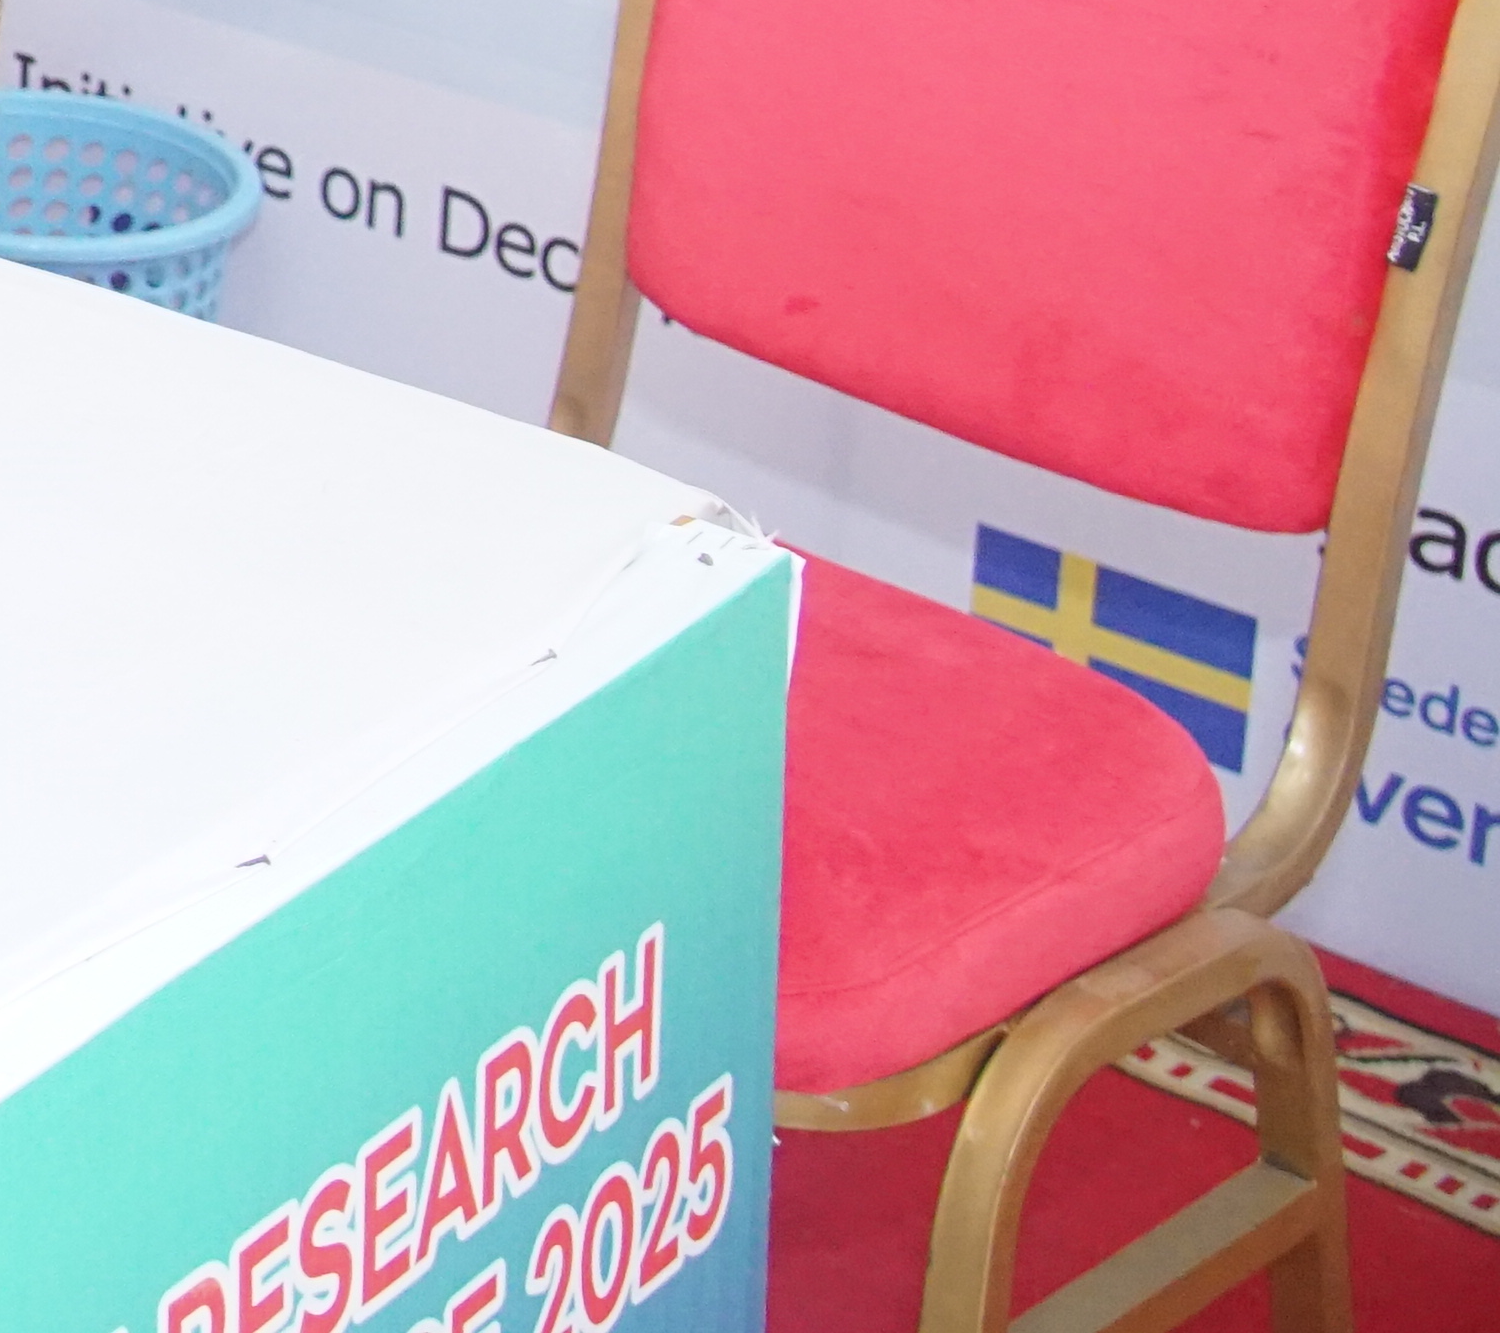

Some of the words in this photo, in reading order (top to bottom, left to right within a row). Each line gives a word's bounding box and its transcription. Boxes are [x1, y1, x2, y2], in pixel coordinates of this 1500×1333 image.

[319, 161, 406, 241] on
[438, 188, 581, 293] Dec
[526, 1073, 734, 1333] 2025
